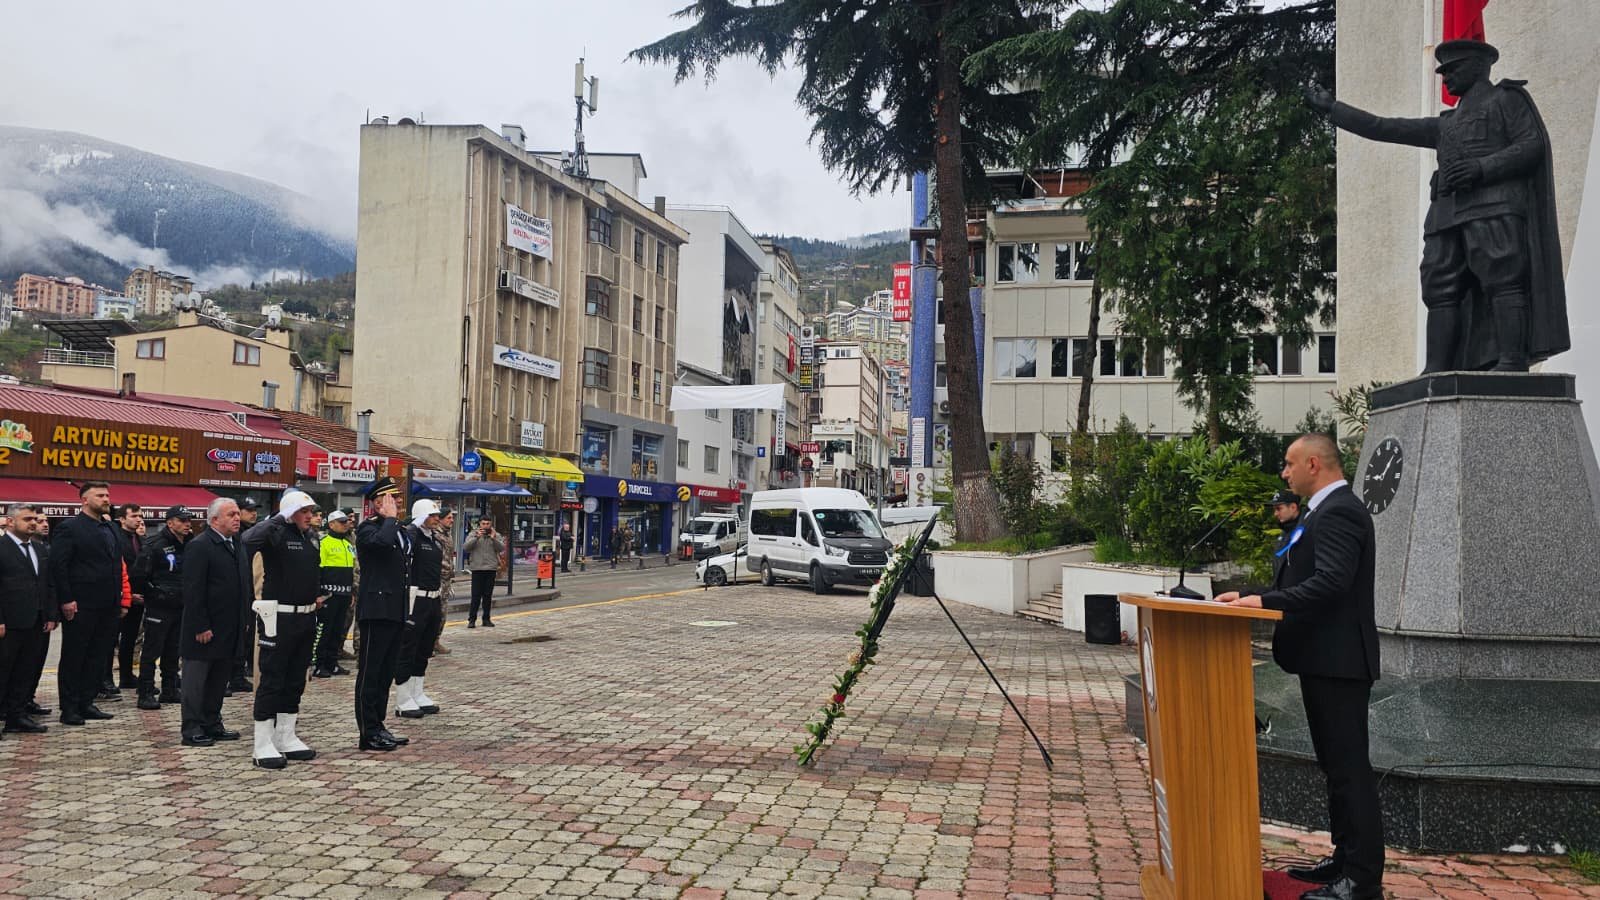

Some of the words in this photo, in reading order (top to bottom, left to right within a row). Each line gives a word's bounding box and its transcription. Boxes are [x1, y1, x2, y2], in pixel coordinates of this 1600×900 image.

[127, 432, 179, 453] SEBZE
[42, 447, 107, 470] MEYVE
[111, 451, 185, 474] DÜNYASI
[628, 484, 652, 496] TURKCELL
